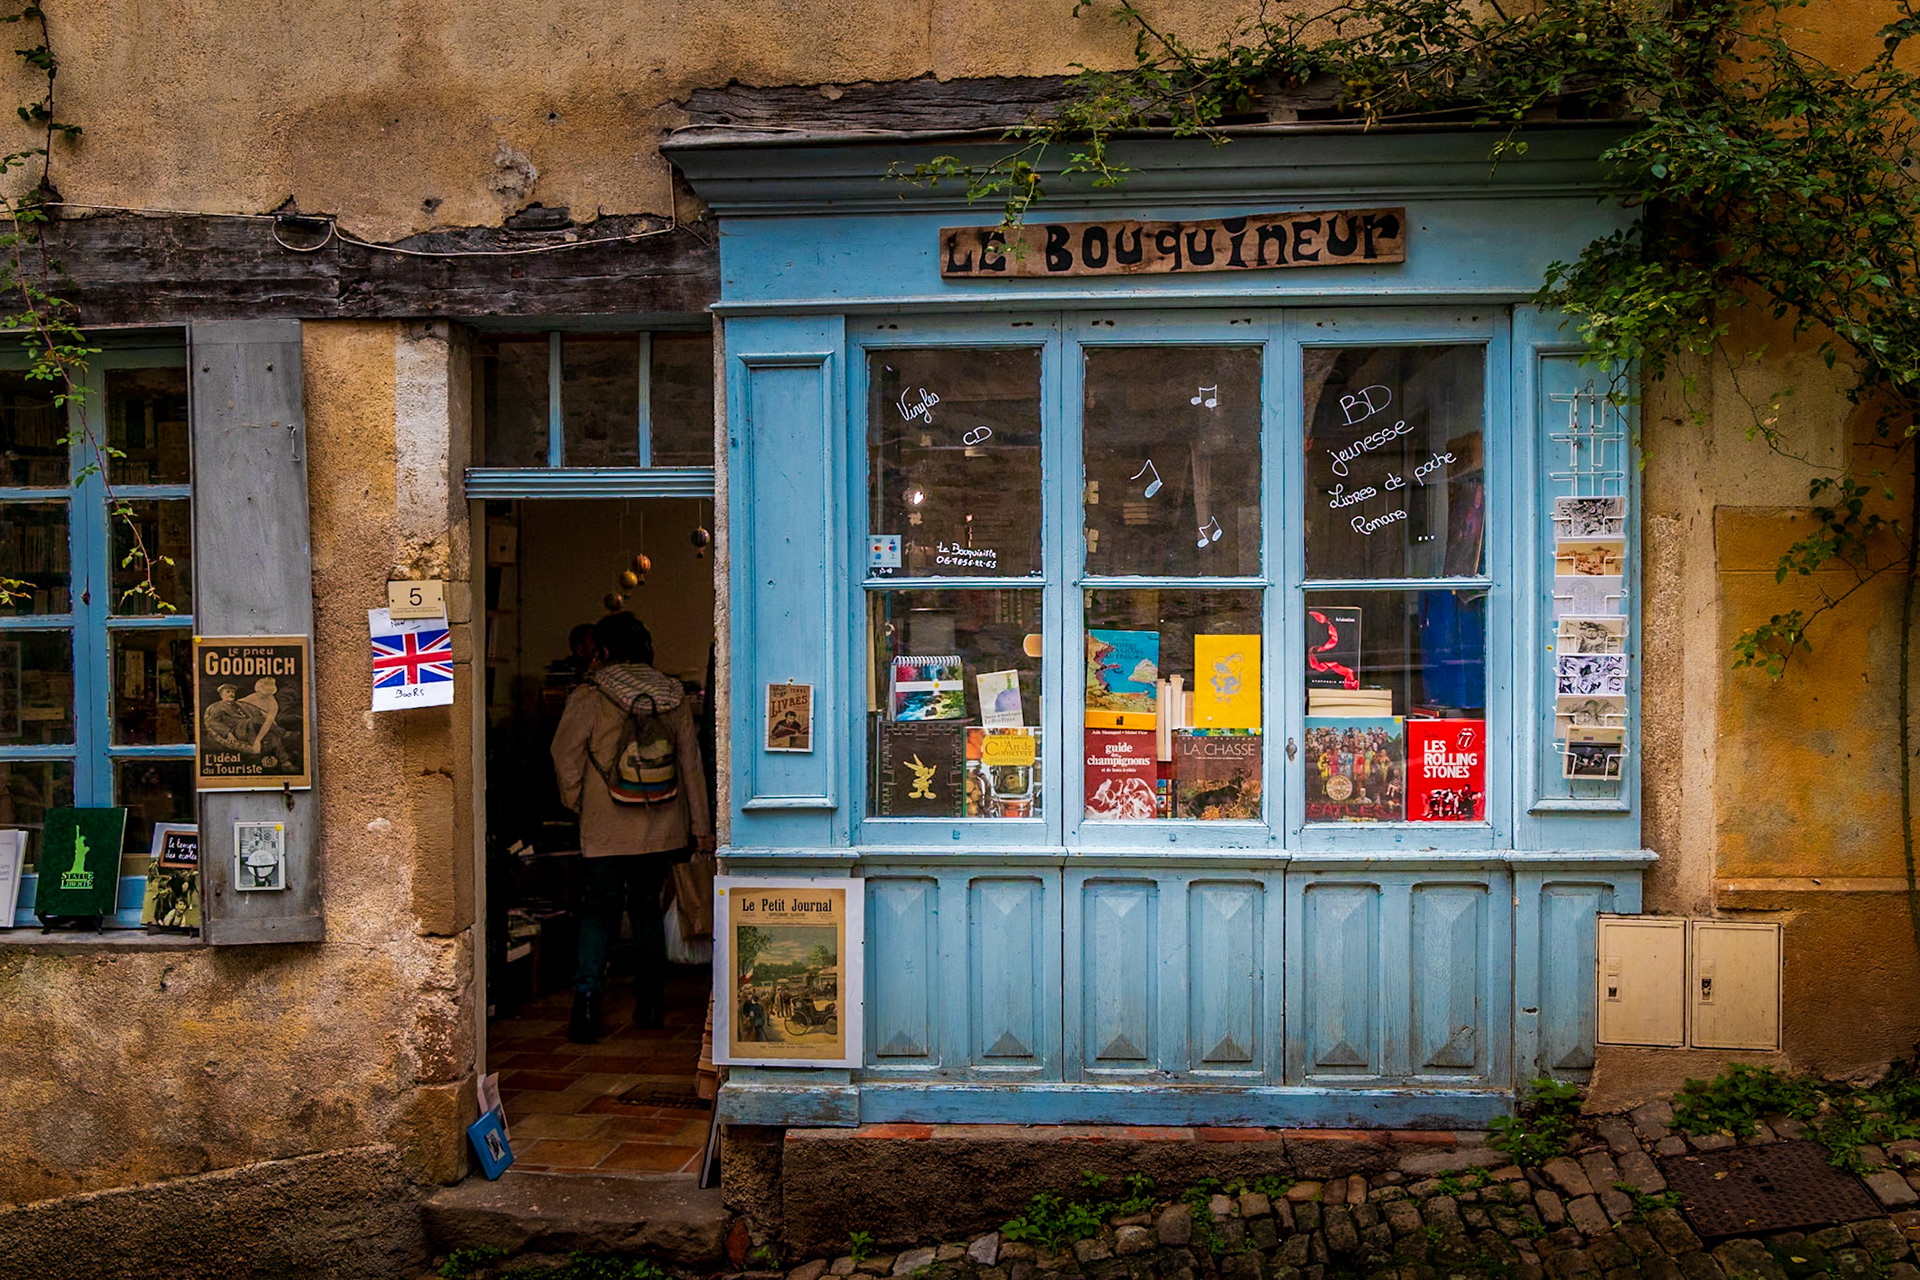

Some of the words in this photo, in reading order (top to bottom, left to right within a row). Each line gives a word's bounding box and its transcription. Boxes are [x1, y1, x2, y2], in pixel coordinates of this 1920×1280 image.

[945, 230, 1006, 272] LE
[896, 386, 940, 424] Vinyles
[1339, 384, 1392, 427] BD
[963, 426, 993, 446] CD
[1384, 472, 1406, 492] de
[1414, 452, 1457, 486] poche
[1351, 509, 1408, 535] Romans
[409, 587, 423, 607] 5
[228, 648, 240, 657] Le
[243, 648, 274, 657] pneu
[205, 651, 296, 676] GOODRICH
[770, 695, 808, 718] LIVRES
[1105, 742, 1133, 754] guide
[1183, 743, 1200, 755] LA
[1204, 743, 1256, 756] CHASSE
[1424, 740, 1447, 753] LES
[205, 753, 241, 766] L'idéal
[1087, 755, 1151, 767] champignons
[1424, 752, 1478, 766] ROLLING
[202, 767, 214, 775] du
[215, 763, 263, 775] Touriste
[1423, 765, 1470, 779] STONES
[742, 898, 755, 912] Le
[761, 898, 785, 912] Petit
[791, 898, 832, 912] Journal
